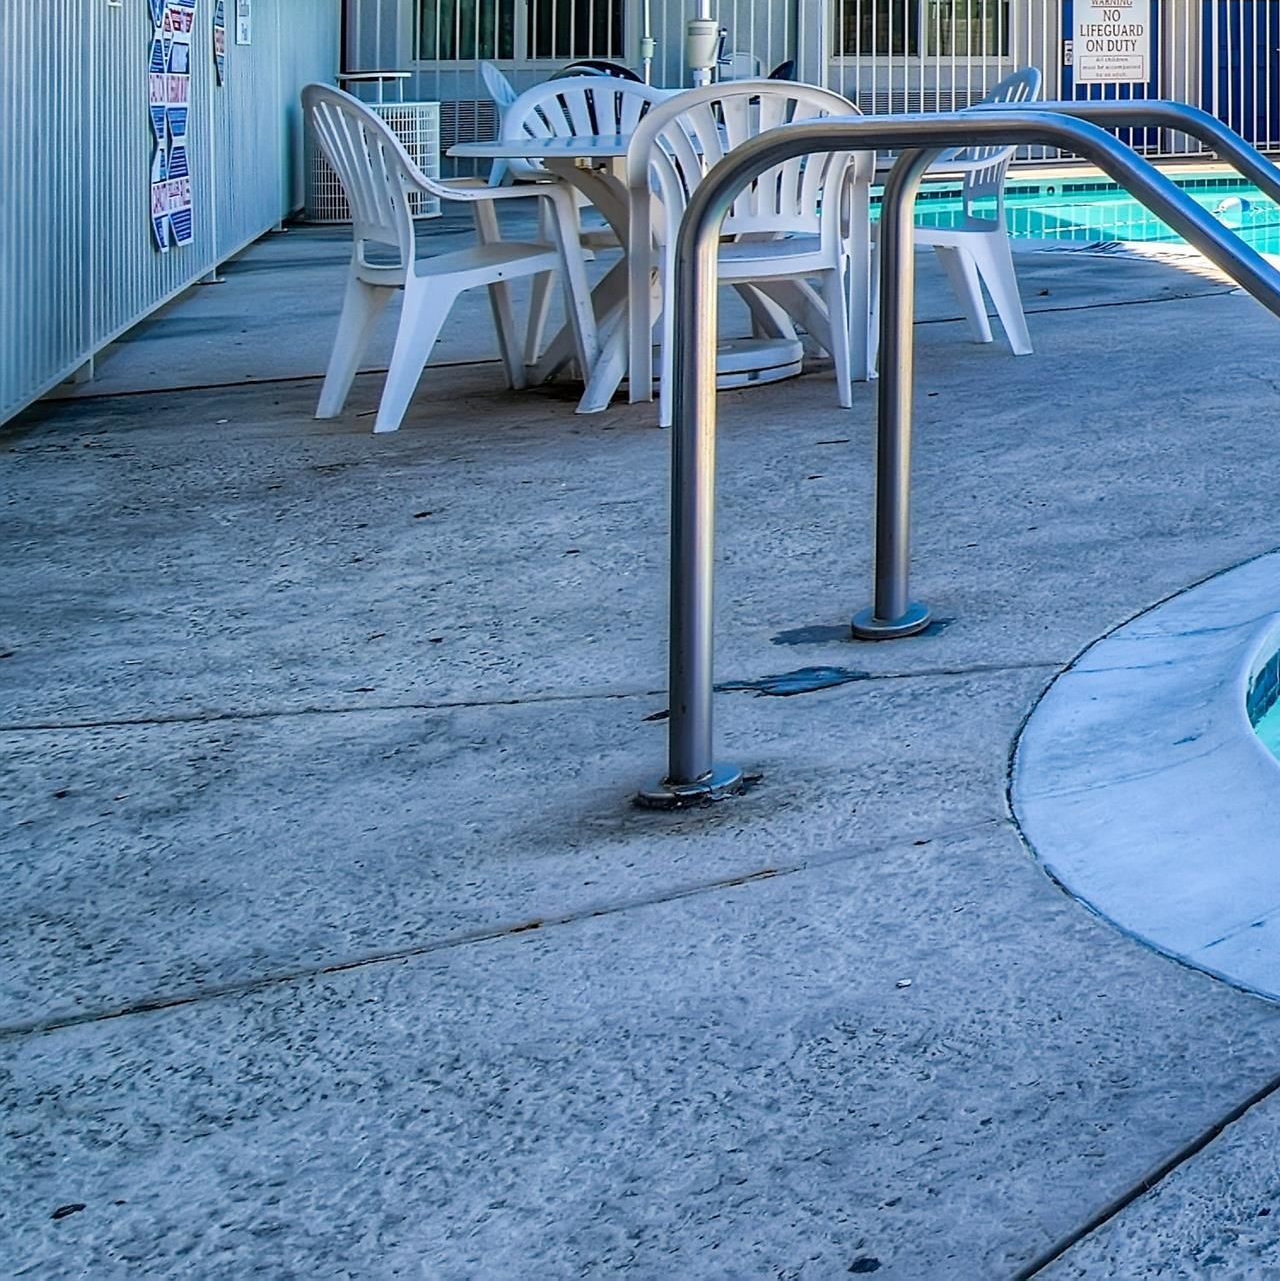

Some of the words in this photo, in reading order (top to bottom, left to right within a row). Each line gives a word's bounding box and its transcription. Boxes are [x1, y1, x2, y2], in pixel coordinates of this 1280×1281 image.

[1103, 9, 1121, 22] NO
[1080, 24, 1144, 37] LIFEGUARD
[1086, 39, 1104, 52] ON
[1107, 39, 1137, 52] DUTY
